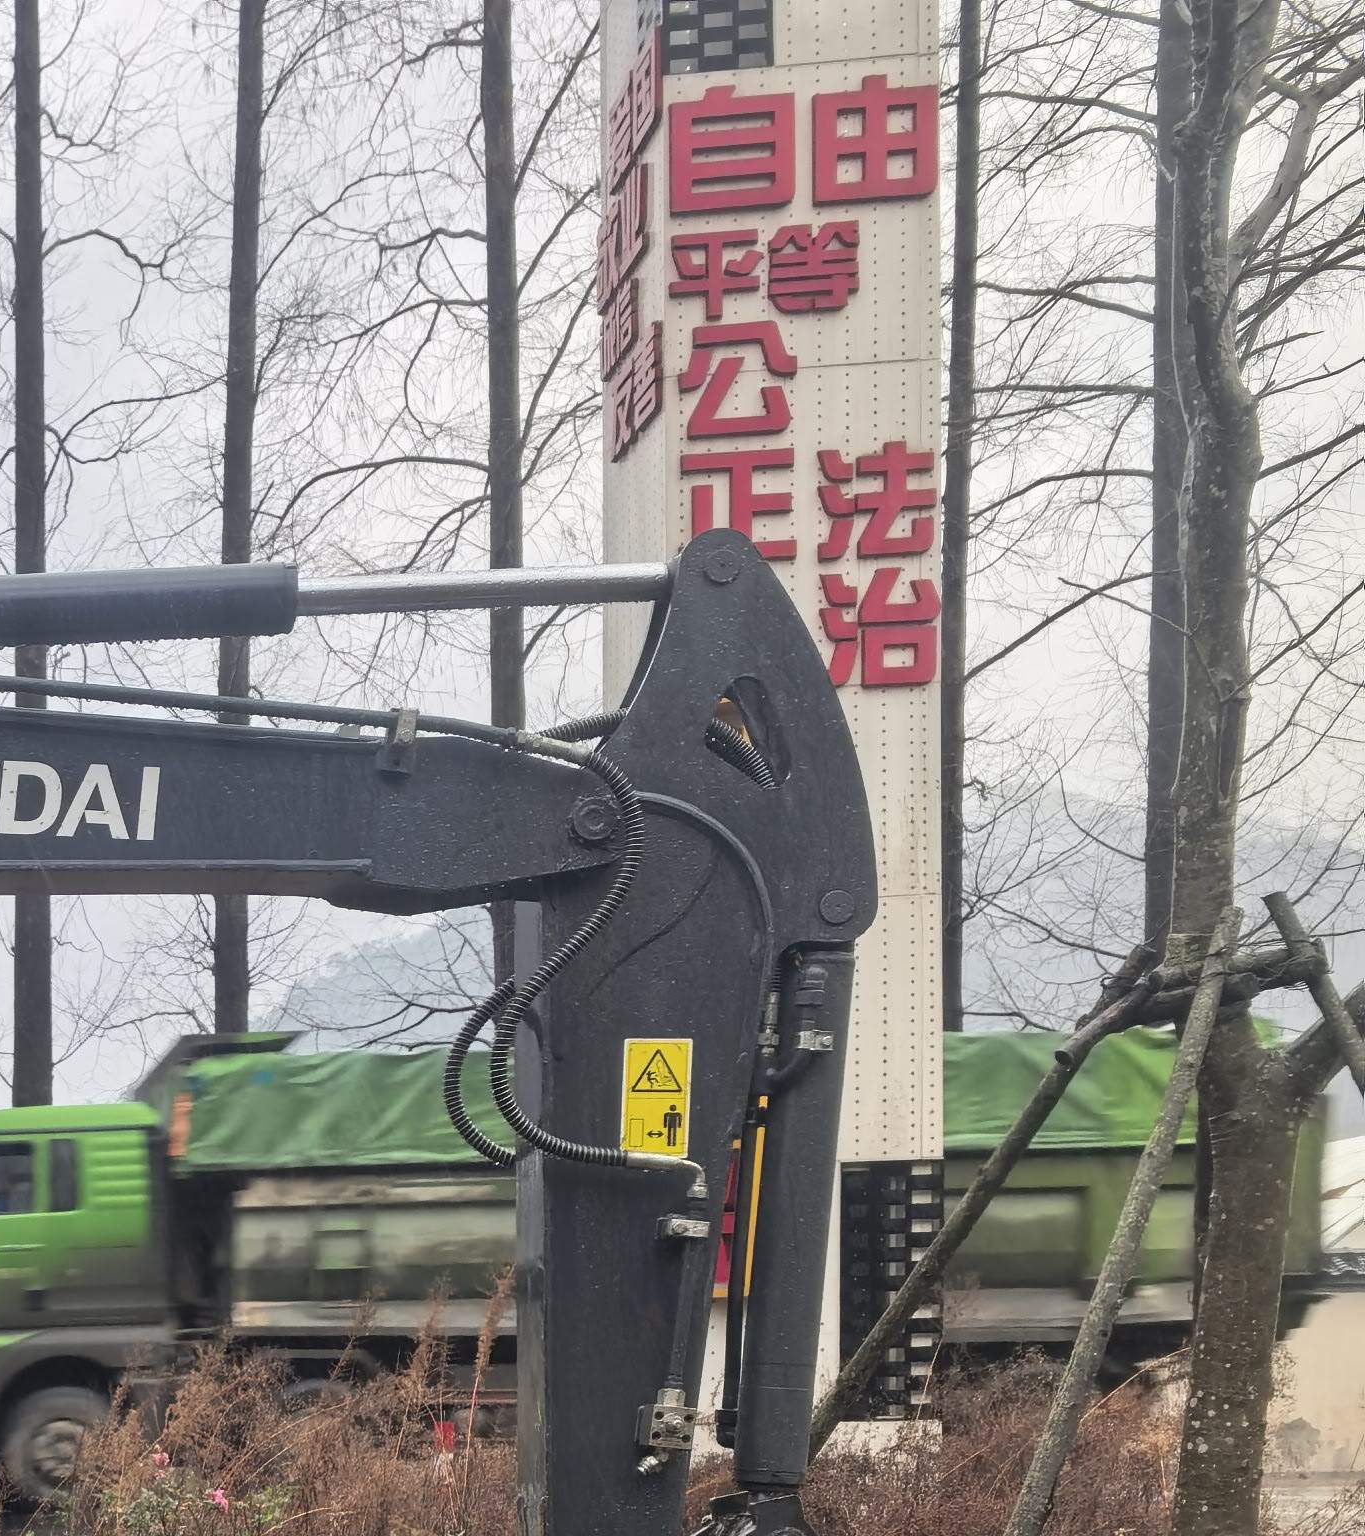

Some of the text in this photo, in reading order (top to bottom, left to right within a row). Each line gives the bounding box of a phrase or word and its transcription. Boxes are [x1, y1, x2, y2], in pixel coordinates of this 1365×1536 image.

[668, 76, 939, 212] 自由
[669, 219, 860, 320] 平等
[816, 441, 941, 689] 法治
